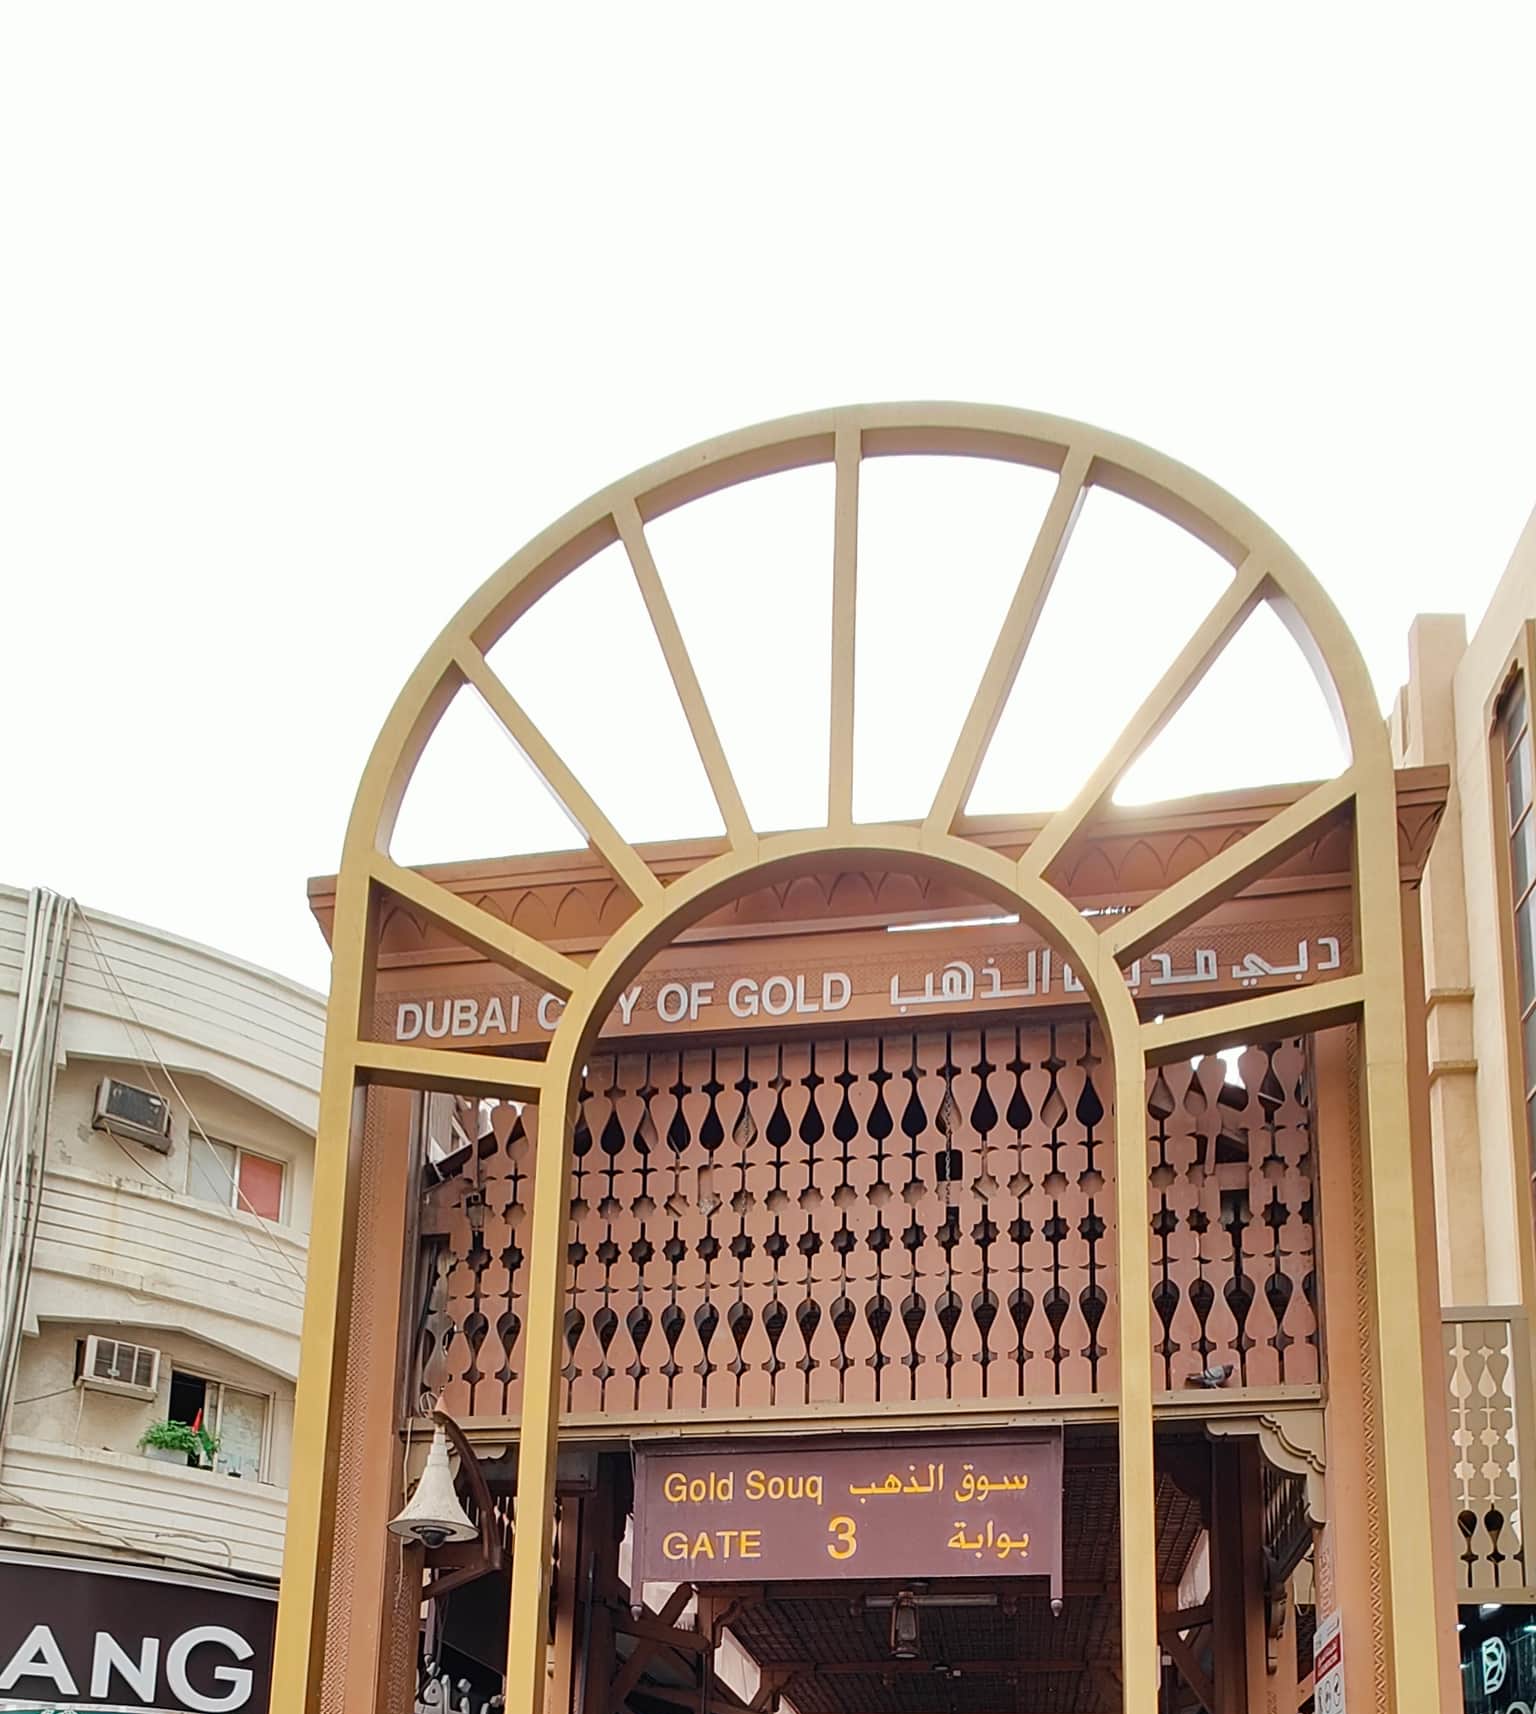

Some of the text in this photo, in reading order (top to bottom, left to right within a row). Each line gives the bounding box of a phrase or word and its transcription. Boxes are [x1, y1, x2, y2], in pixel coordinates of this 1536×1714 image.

[890, 948, 1050, 1014] الذهب
[1232, 937, 1341, 987] دبي
[396, 972, 852, 1040] DUBAI CY OF GOLD
[663, 1470, 823, 1506] Gold Souq
[848, 1463, 1030, 1504] سوق الذهب
[662, 1516, 858, 1560] GATE 3
[946, 1520, 1030, 1559] بوابة
